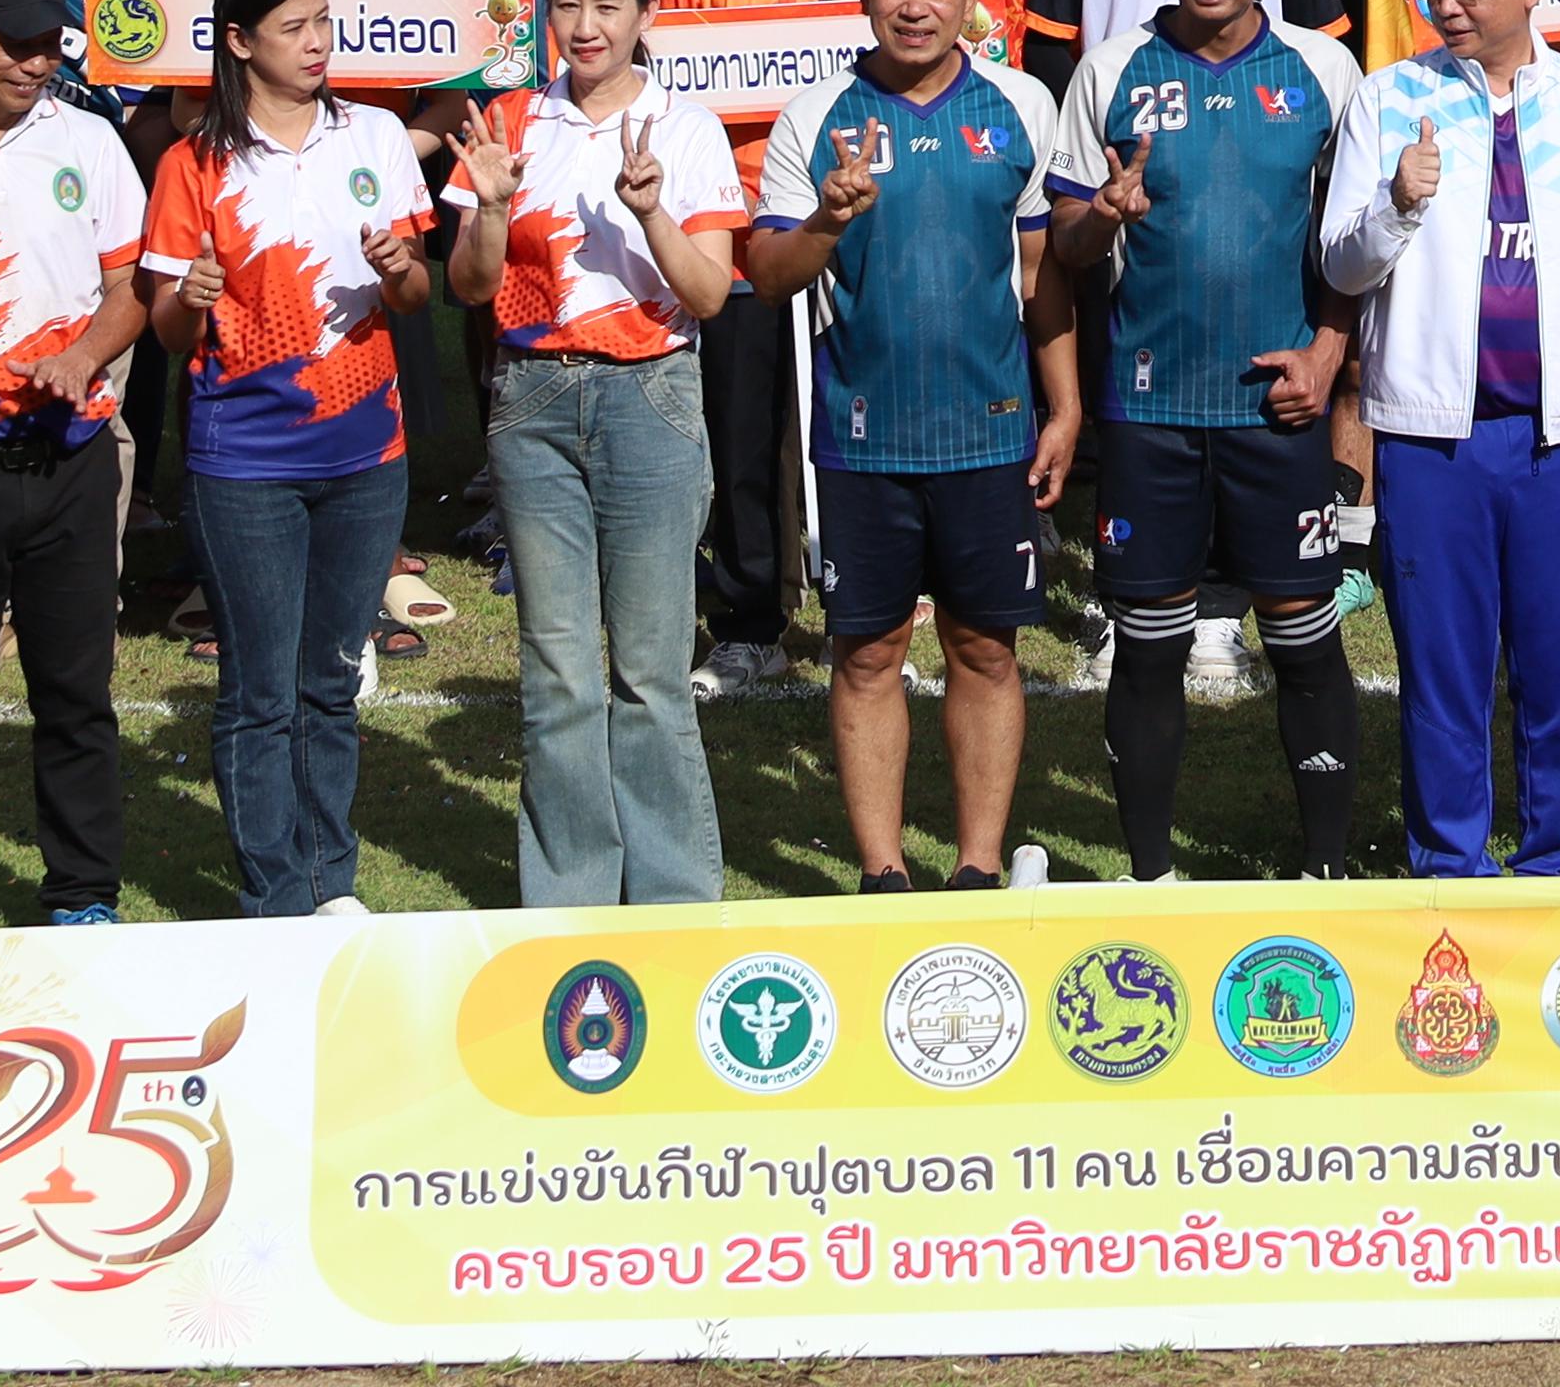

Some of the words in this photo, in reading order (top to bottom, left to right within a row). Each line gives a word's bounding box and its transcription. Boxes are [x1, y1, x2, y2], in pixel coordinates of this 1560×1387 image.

[1130, 80, 1189, 134] 23
[1297, 503, 1340, 560] 23
[895, 955, 1016, 1008] เทศบาลนครแม่สอด
[143, 1080, 175, 1103] th
[354, 1145, 994, 1216] การแข่งขันกีฬาฟุตบอล
[1013, 1146, 1055, 1189] 11
[1076, 1146, 1157, 1188] คน
[454, 1243, 704, 1291] ครบรอบ
[725, 1236, 807, 1285] 25
[826, 1222, 871, 1282] ปี
